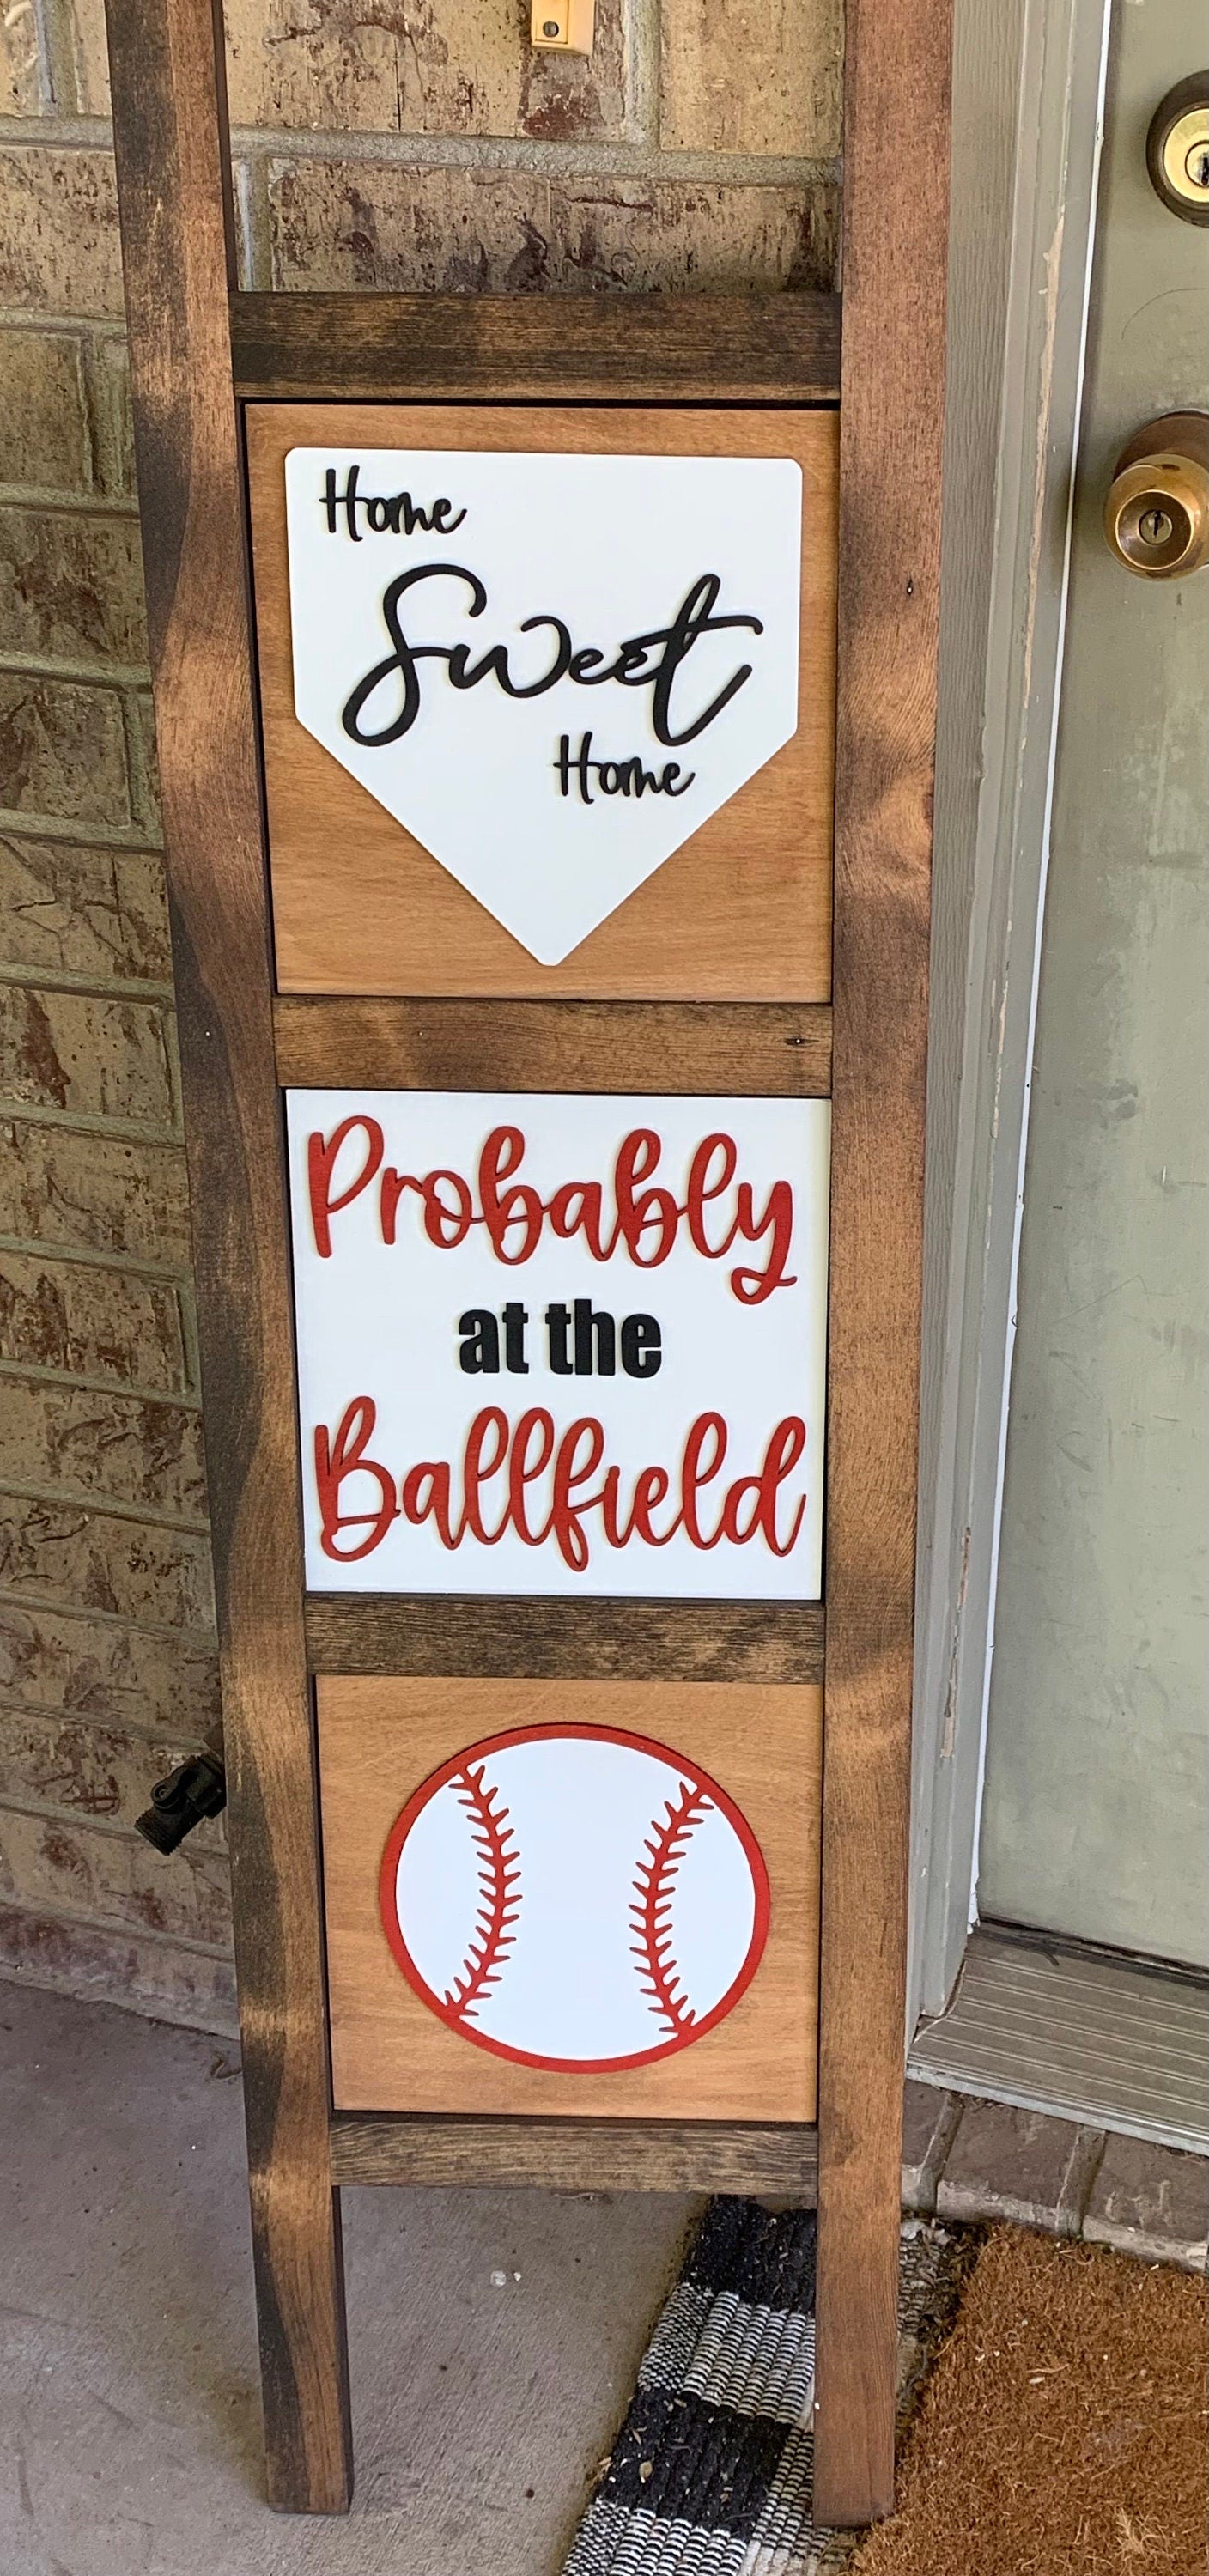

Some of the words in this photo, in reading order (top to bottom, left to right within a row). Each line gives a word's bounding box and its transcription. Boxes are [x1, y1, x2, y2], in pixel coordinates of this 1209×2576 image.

[319, 465, 468, 542] Home
[342, 563, 764, 747] Sweet
[552, 731, 696, 805] Home
[307, 1115, 798, 1305] Probably
[458, 1302, 530, 1375] at
[544, 1298, 662, 1378] the
[314, 1395, 807, 1572] Ballfield
